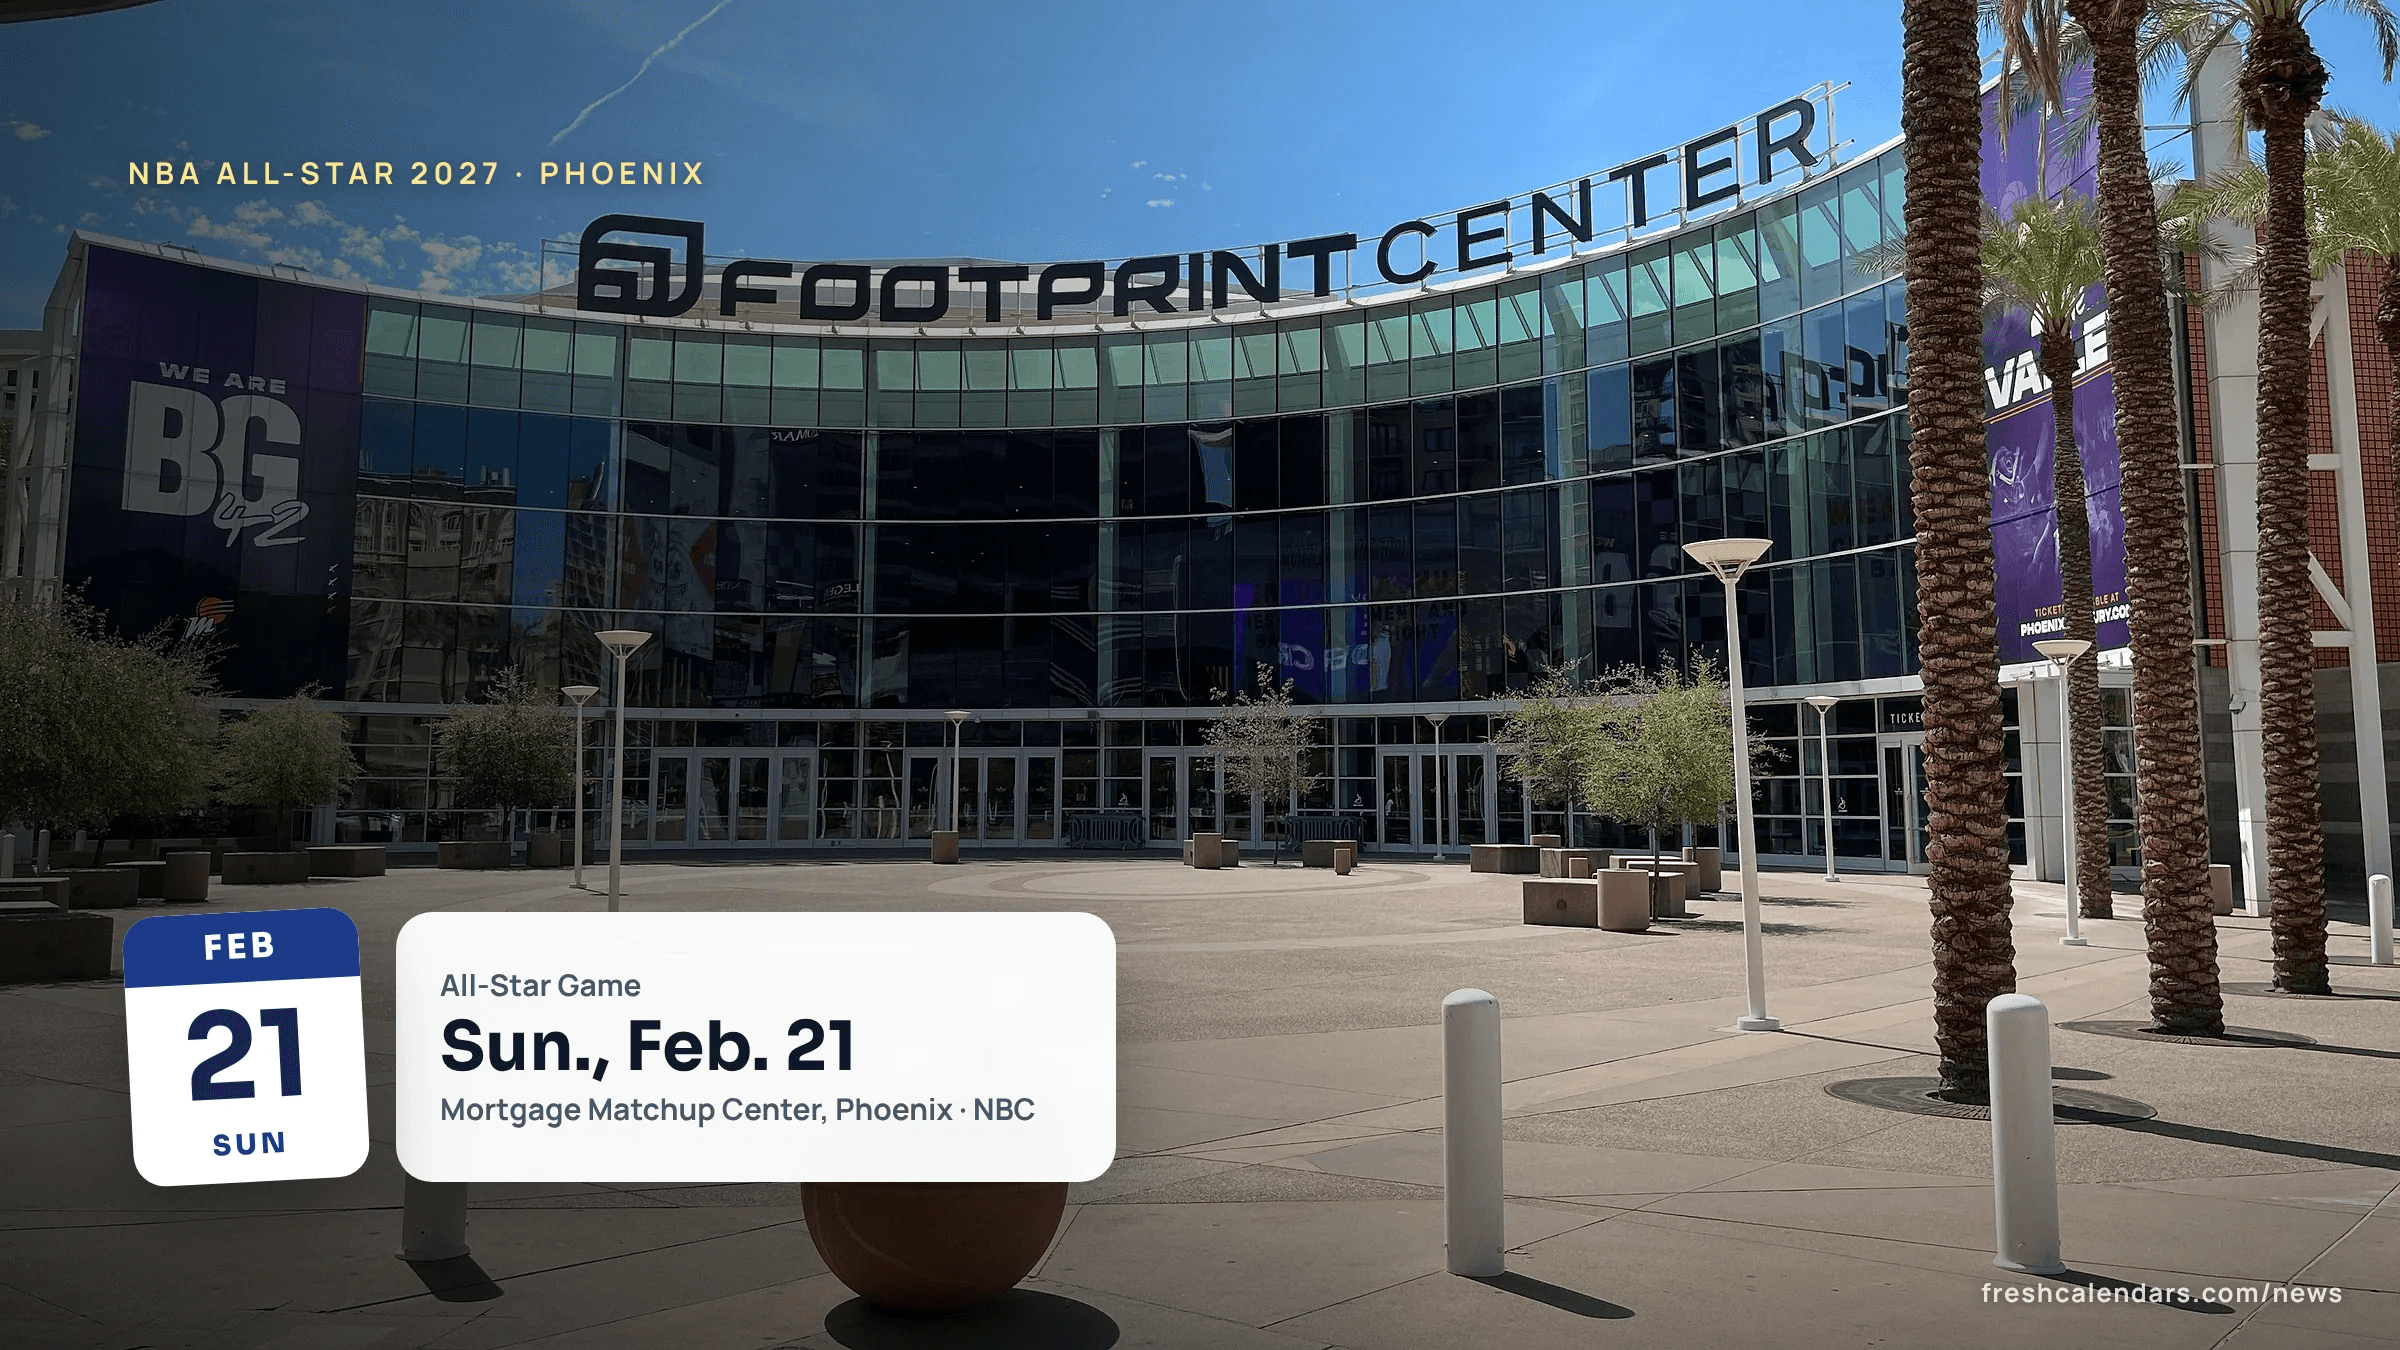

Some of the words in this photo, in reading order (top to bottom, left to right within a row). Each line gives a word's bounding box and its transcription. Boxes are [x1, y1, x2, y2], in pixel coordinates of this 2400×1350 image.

[720, 233, 1357, 322] FOOTPRINT
[1377, 99, 1817, 285] CENTER
[158, 361, 210, 384] WE
[224, 372, 287, 394] ARE
[122, 380, 301, 517] BG
[213, 492, 309, 548] 42
[2035, 604, 2065, 617] TICKET
[2110, 591, 2120, 603] AT
[1890, 712, 1921, 724] TICKE
